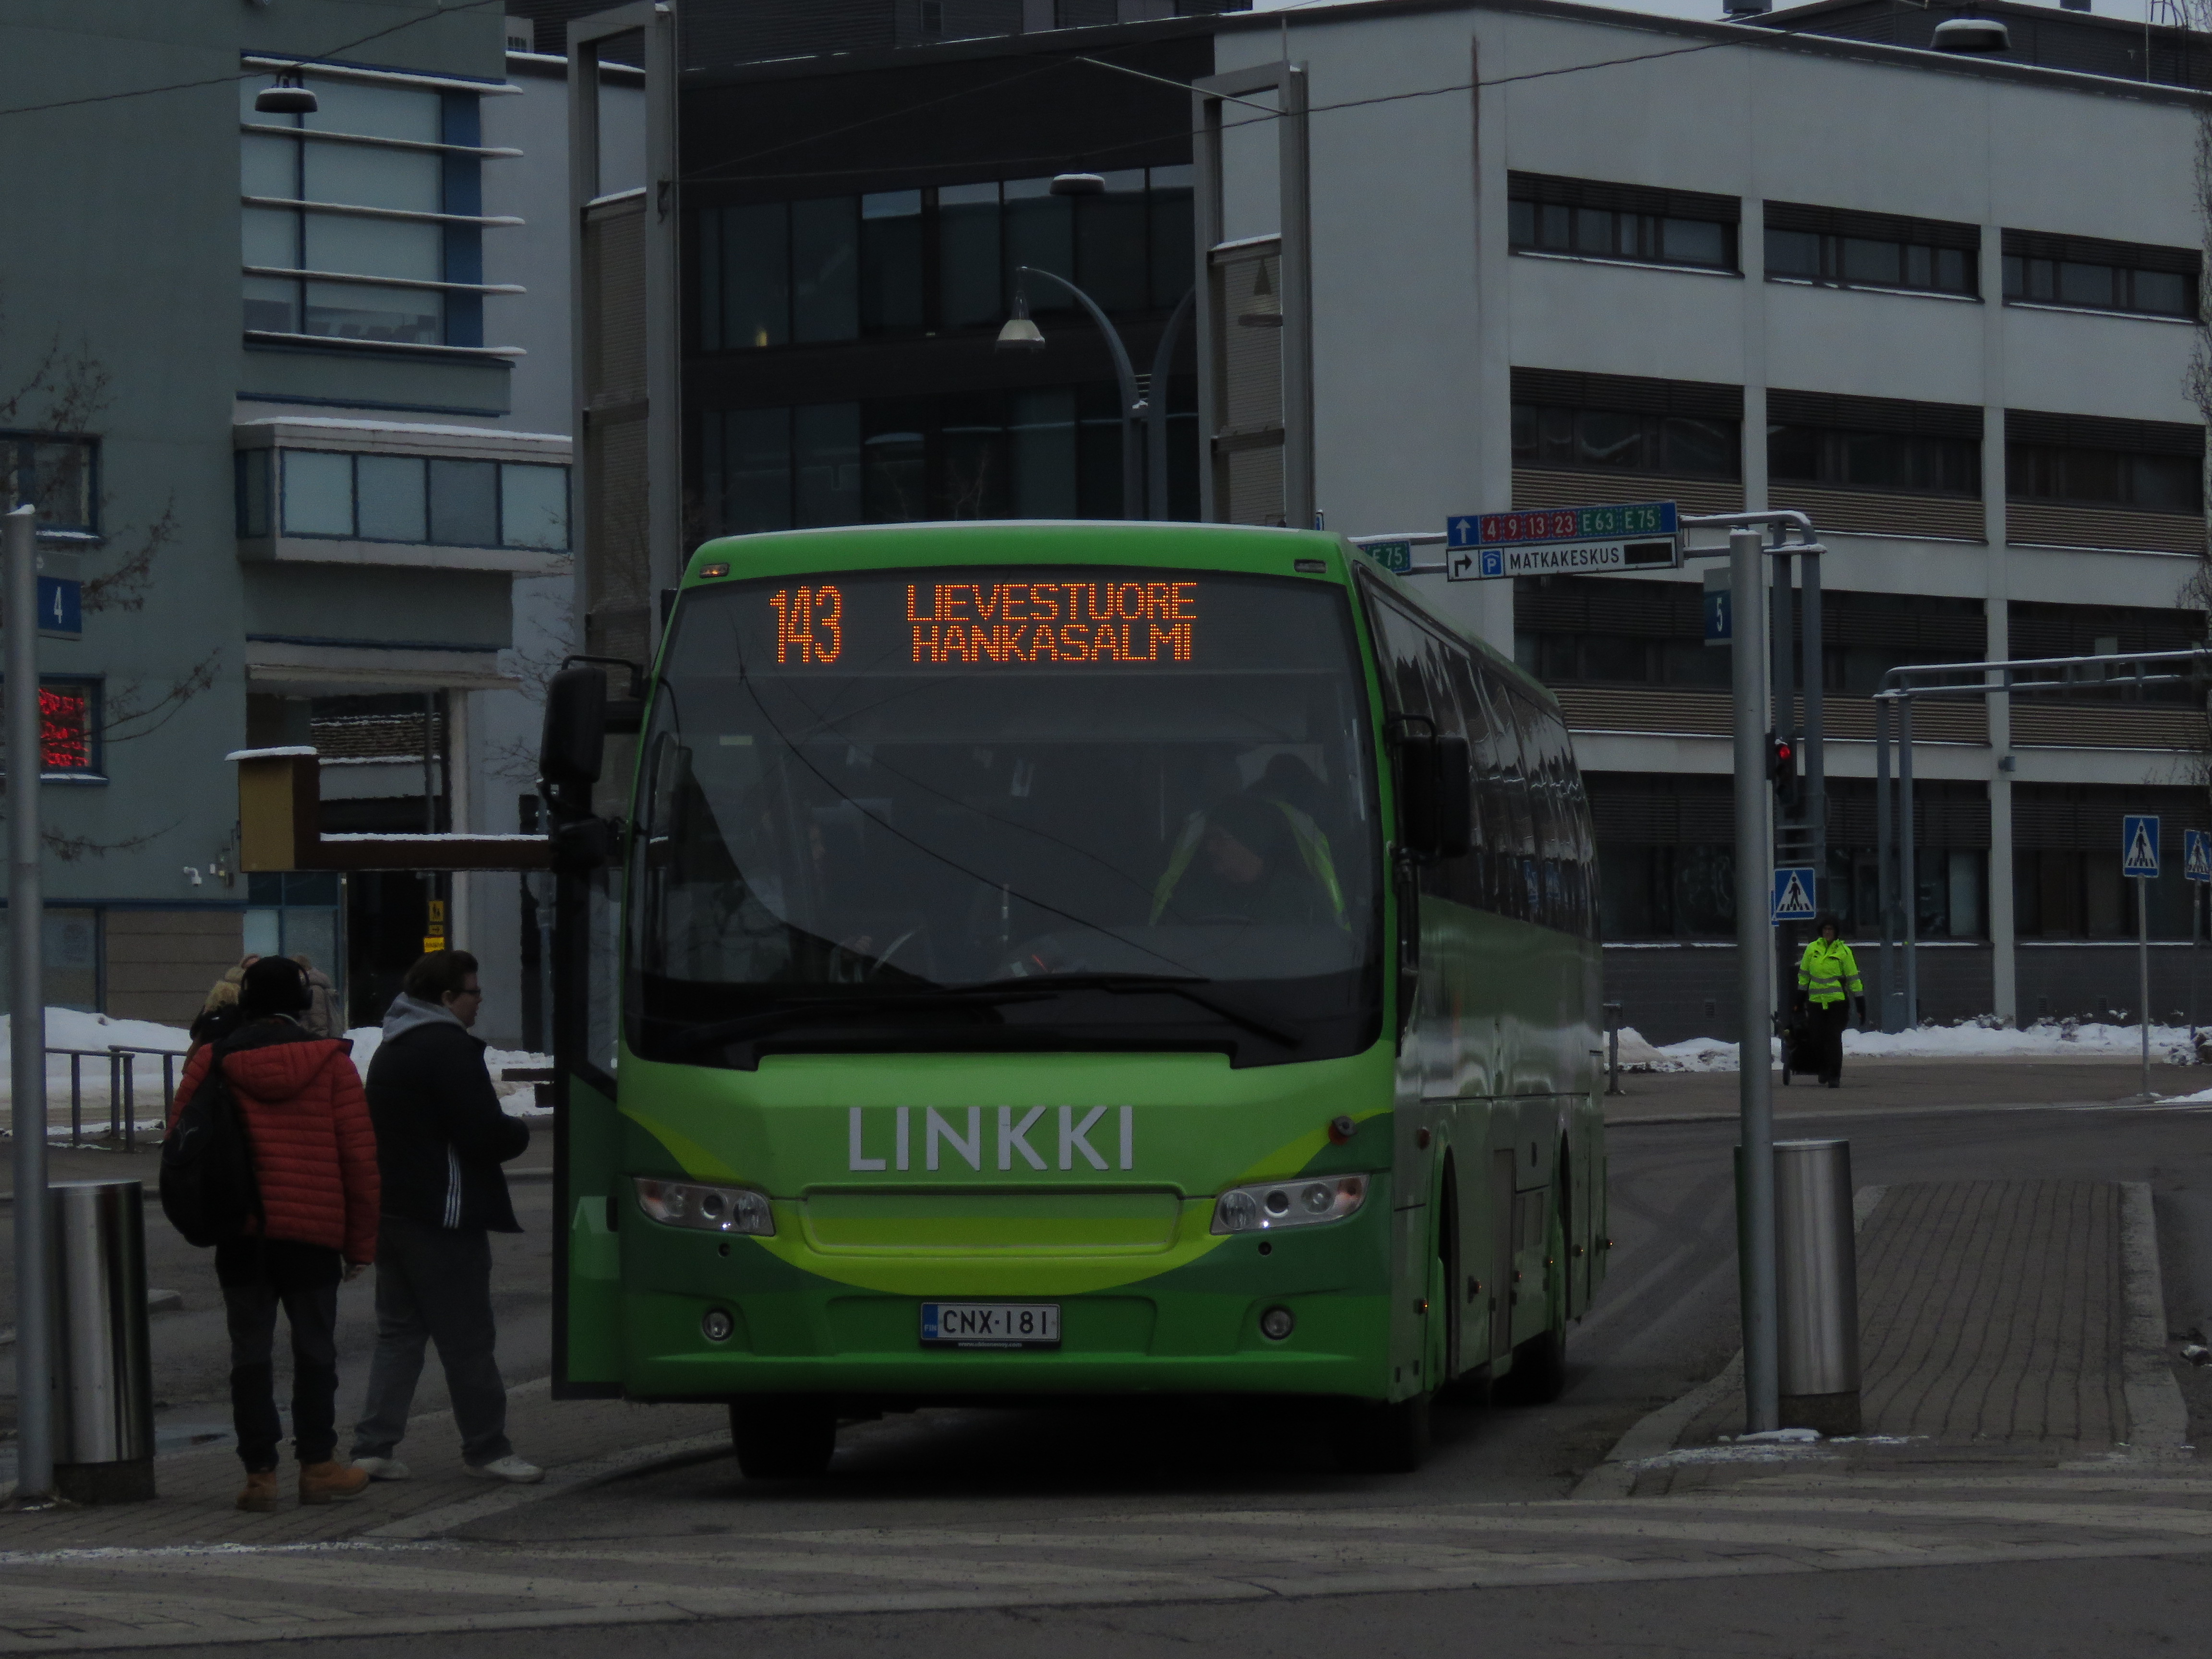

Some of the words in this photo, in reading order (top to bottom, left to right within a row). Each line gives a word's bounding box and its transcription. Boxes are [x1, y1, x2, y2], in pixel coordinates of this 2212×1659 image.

[1487, 520, 1496, 538] 4
[1508, 518, 1517, 536] 9
[1529, 517, 1544, 535] 13
[1555, 516, 1573, 533] 23
[1583, 513, 1591, 532] E
[1595, 512, 1613, 530] 63
[1625, 511, 1634, 529] E
[1638, 509, 1656, 528] 75
[1385, 547, 1403, 566] 75
[1510, 547, 1619, 570] MATKAKESKUS
[53, 586, 63, 624] 4
[769, 585, 842, 664] 143
[906, 581, 1198, 621] LIEVESTUORE
[1717, 597, 1723, 632] 5
[912, 623, 1191, 662] HANKASALMI
[849, 1105, 1133, 1171] LINKKI
[925, 1324, 937, 1332] FIN
[943, 1310, 1046, 1335] CNX-181
